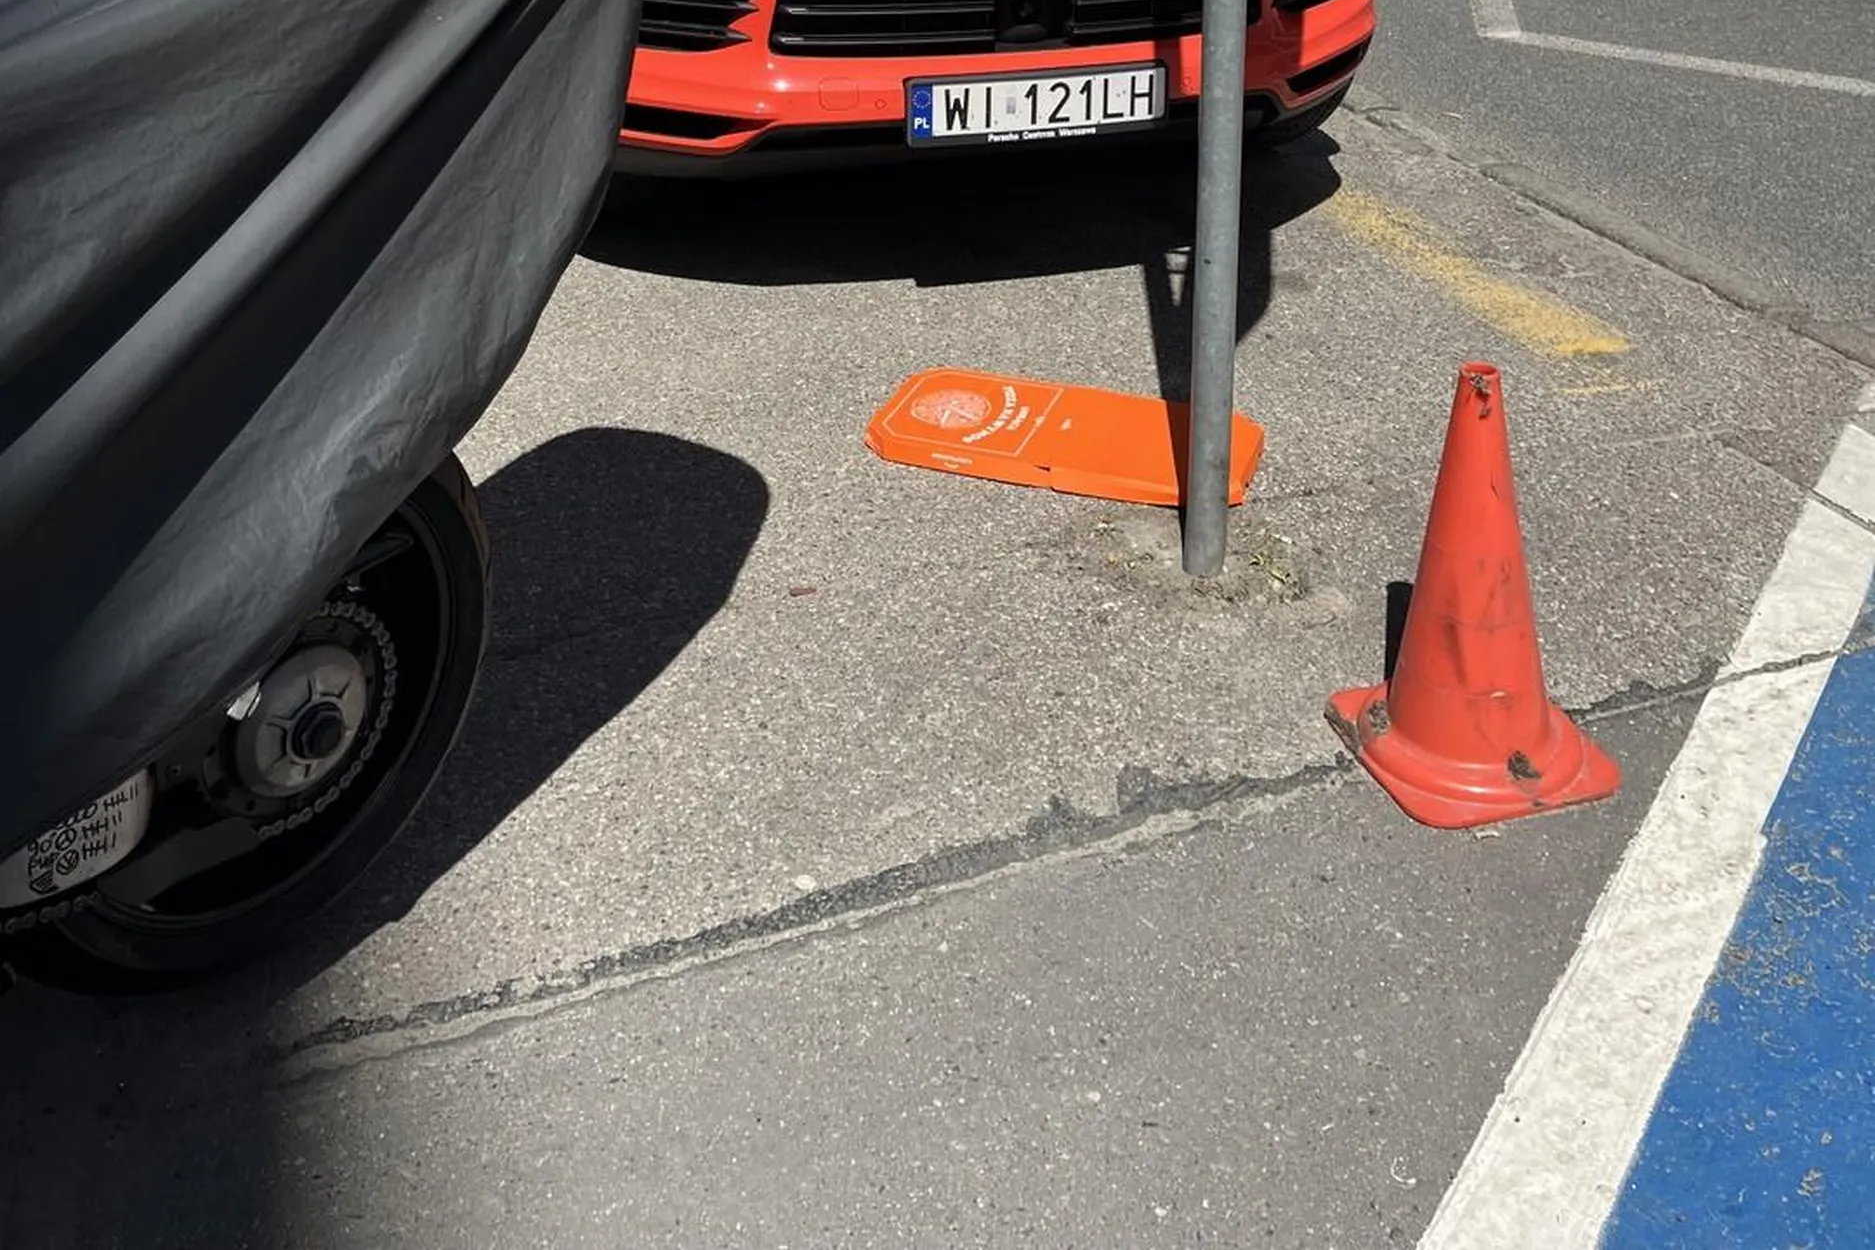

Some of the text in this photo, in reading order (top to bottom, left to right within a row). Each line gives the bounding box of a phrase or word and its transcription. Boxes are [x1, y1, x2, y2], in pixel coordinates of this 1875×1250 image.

[913, 73, 1154, 131] PL WI 121LH
